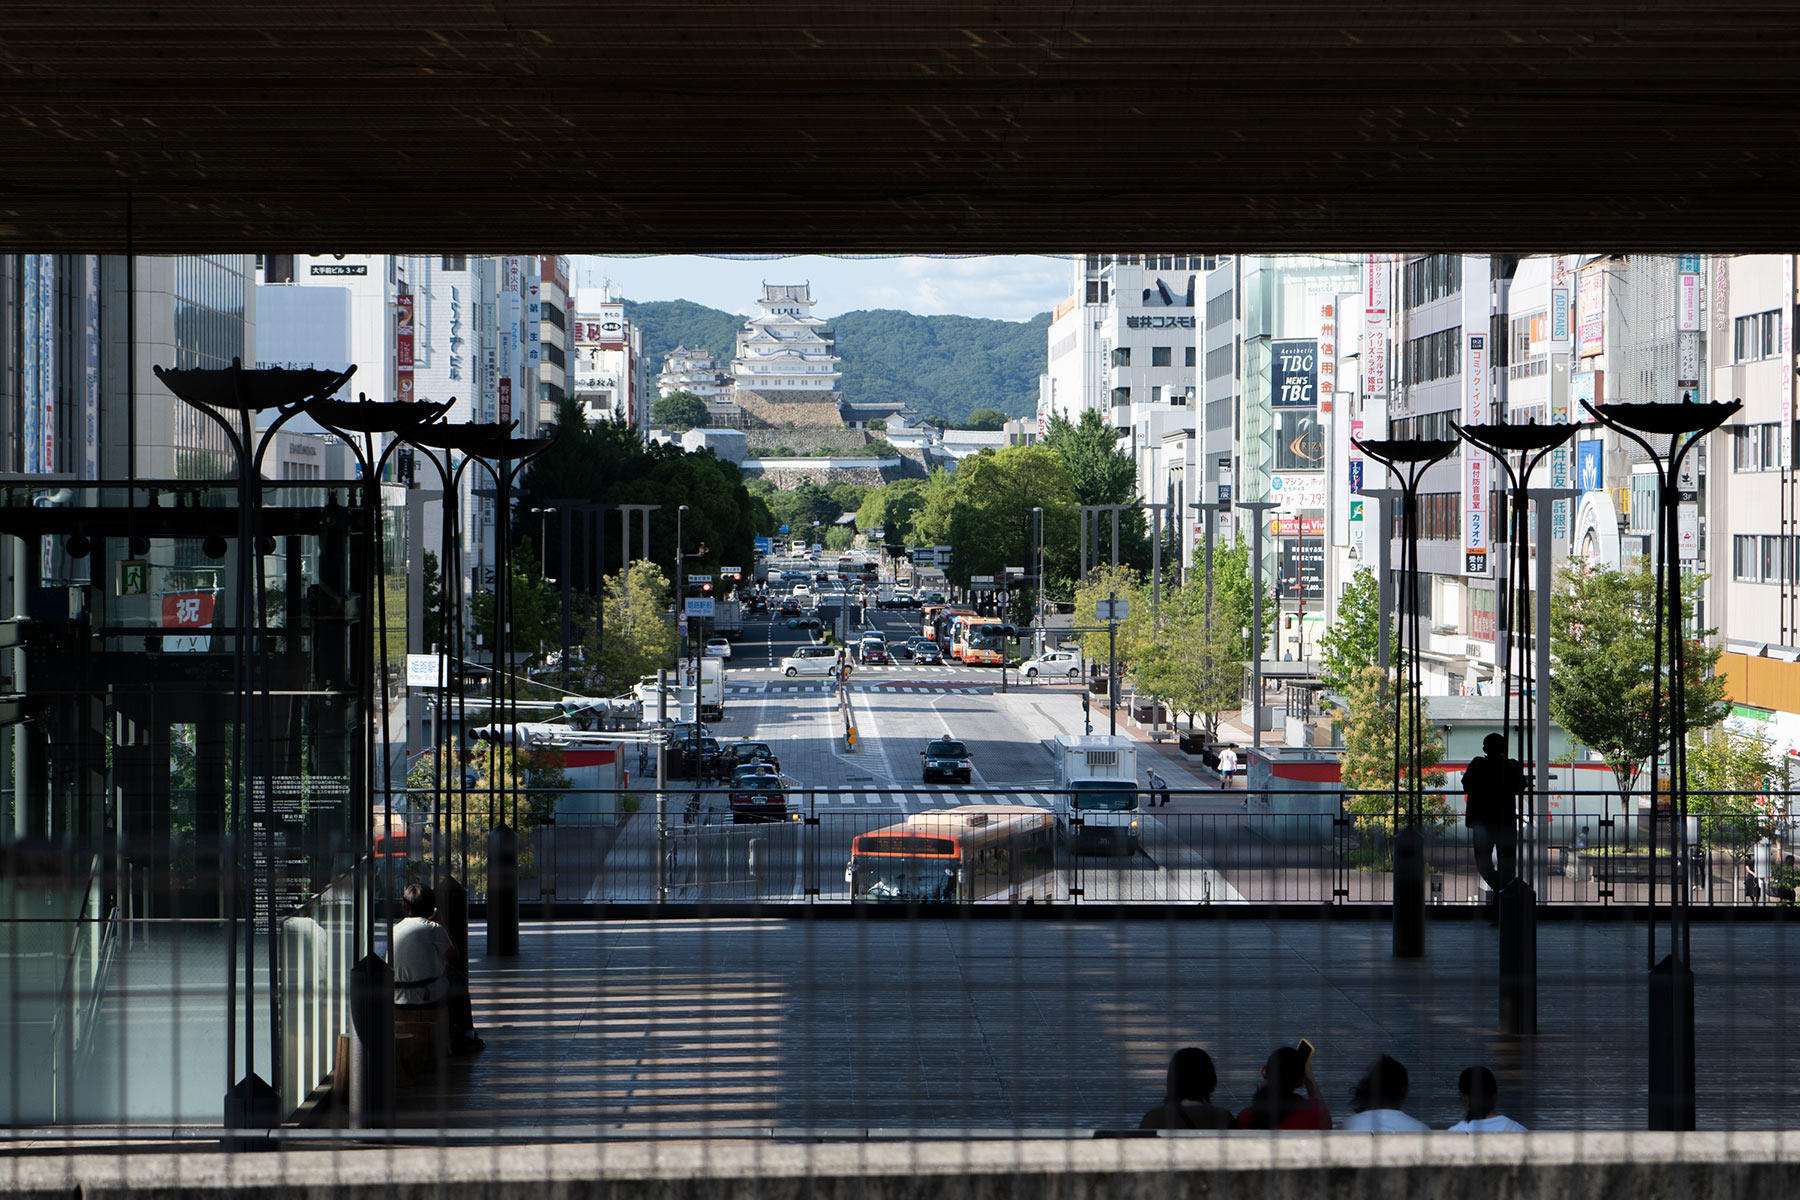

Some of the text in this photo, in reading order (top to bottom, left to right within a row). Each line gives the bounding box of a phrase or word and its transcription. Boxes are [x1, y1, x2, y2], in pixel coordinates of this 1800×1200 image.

[1554, 294, 1566, 337] ADERANS
[1280, 355, 1313, 372] TBC
[1320, 304, 1334, 413] 播州信用金庫
[1286, 376, 1308, 385] MEN'S
[1281, 385, 1312, 402] TBC
[1472, 513, 1481, 547] カラオケ
[1469, 555, 1484, 563] 受付
[1470, 563, 1484, 572] 3F
[176, 597, 200, 623] 祝
